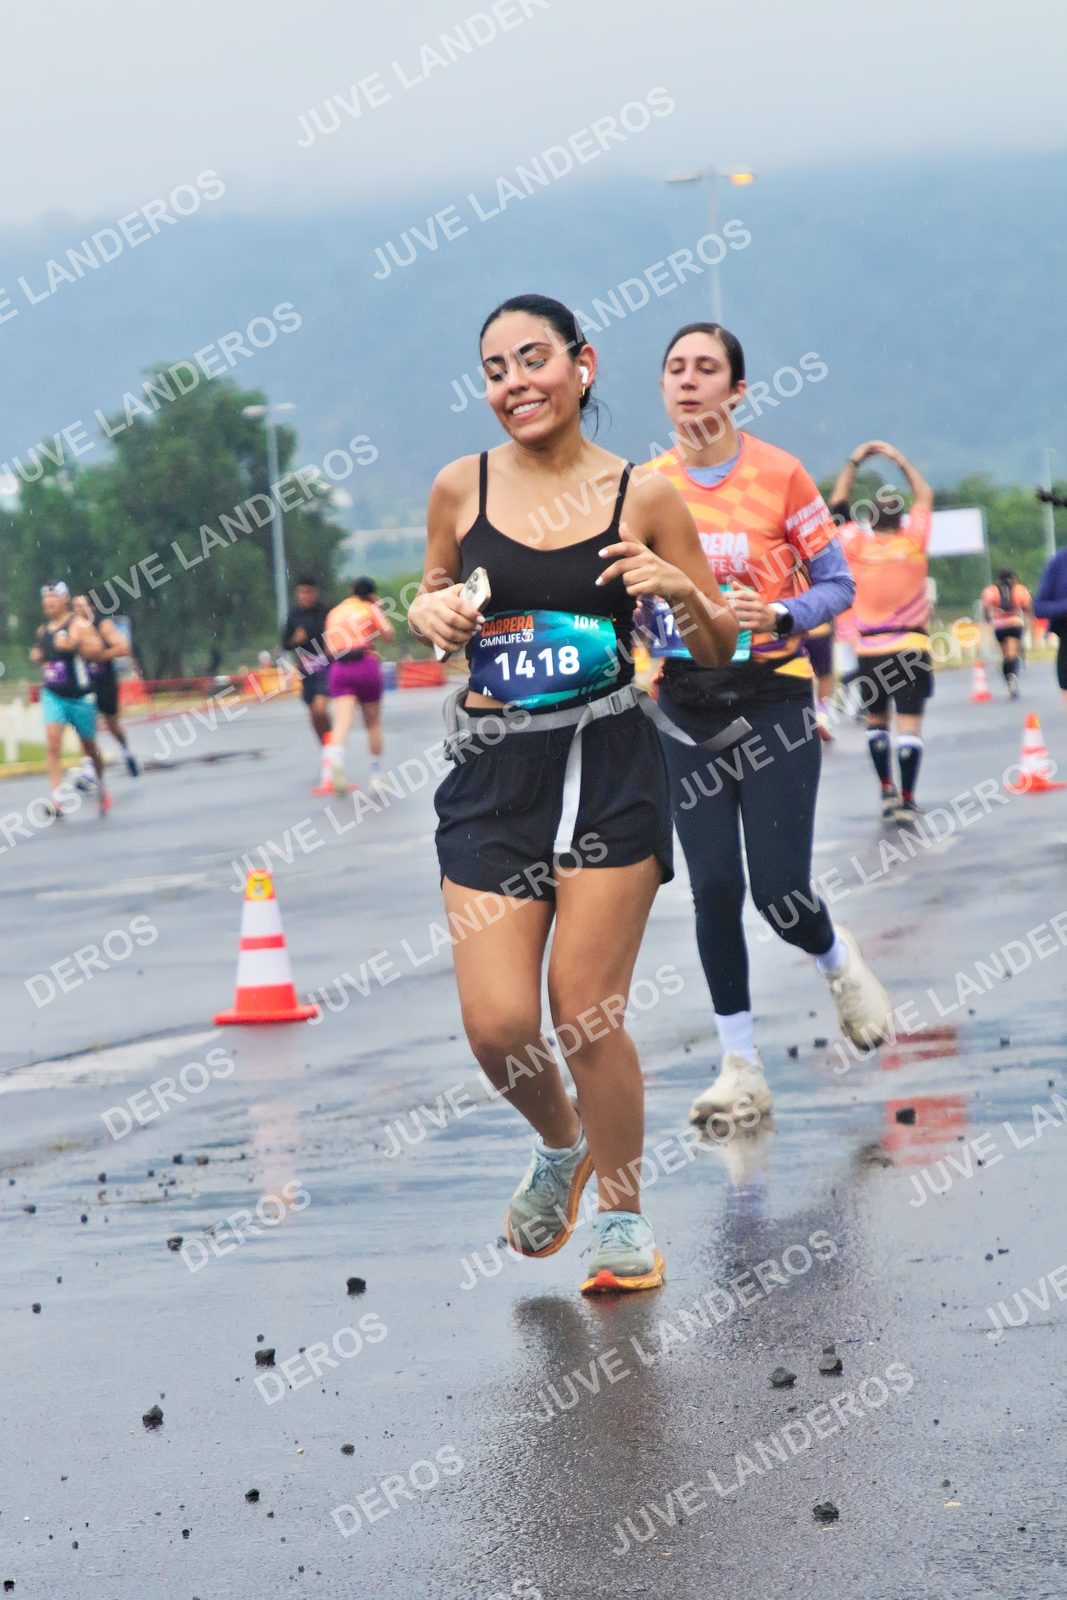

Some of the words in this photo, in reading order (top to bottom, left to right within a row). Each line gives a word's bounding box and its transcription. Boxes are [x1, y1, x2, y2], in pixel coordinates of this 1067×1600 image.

[699, 532, 749, 556] RERA
[480, 614, 534, 638] CARRERA
[574, 615, 600, 630] 10K
[480, 633, 520, 648] OMNILIFE
[495, 646, 580, 681] 1418
